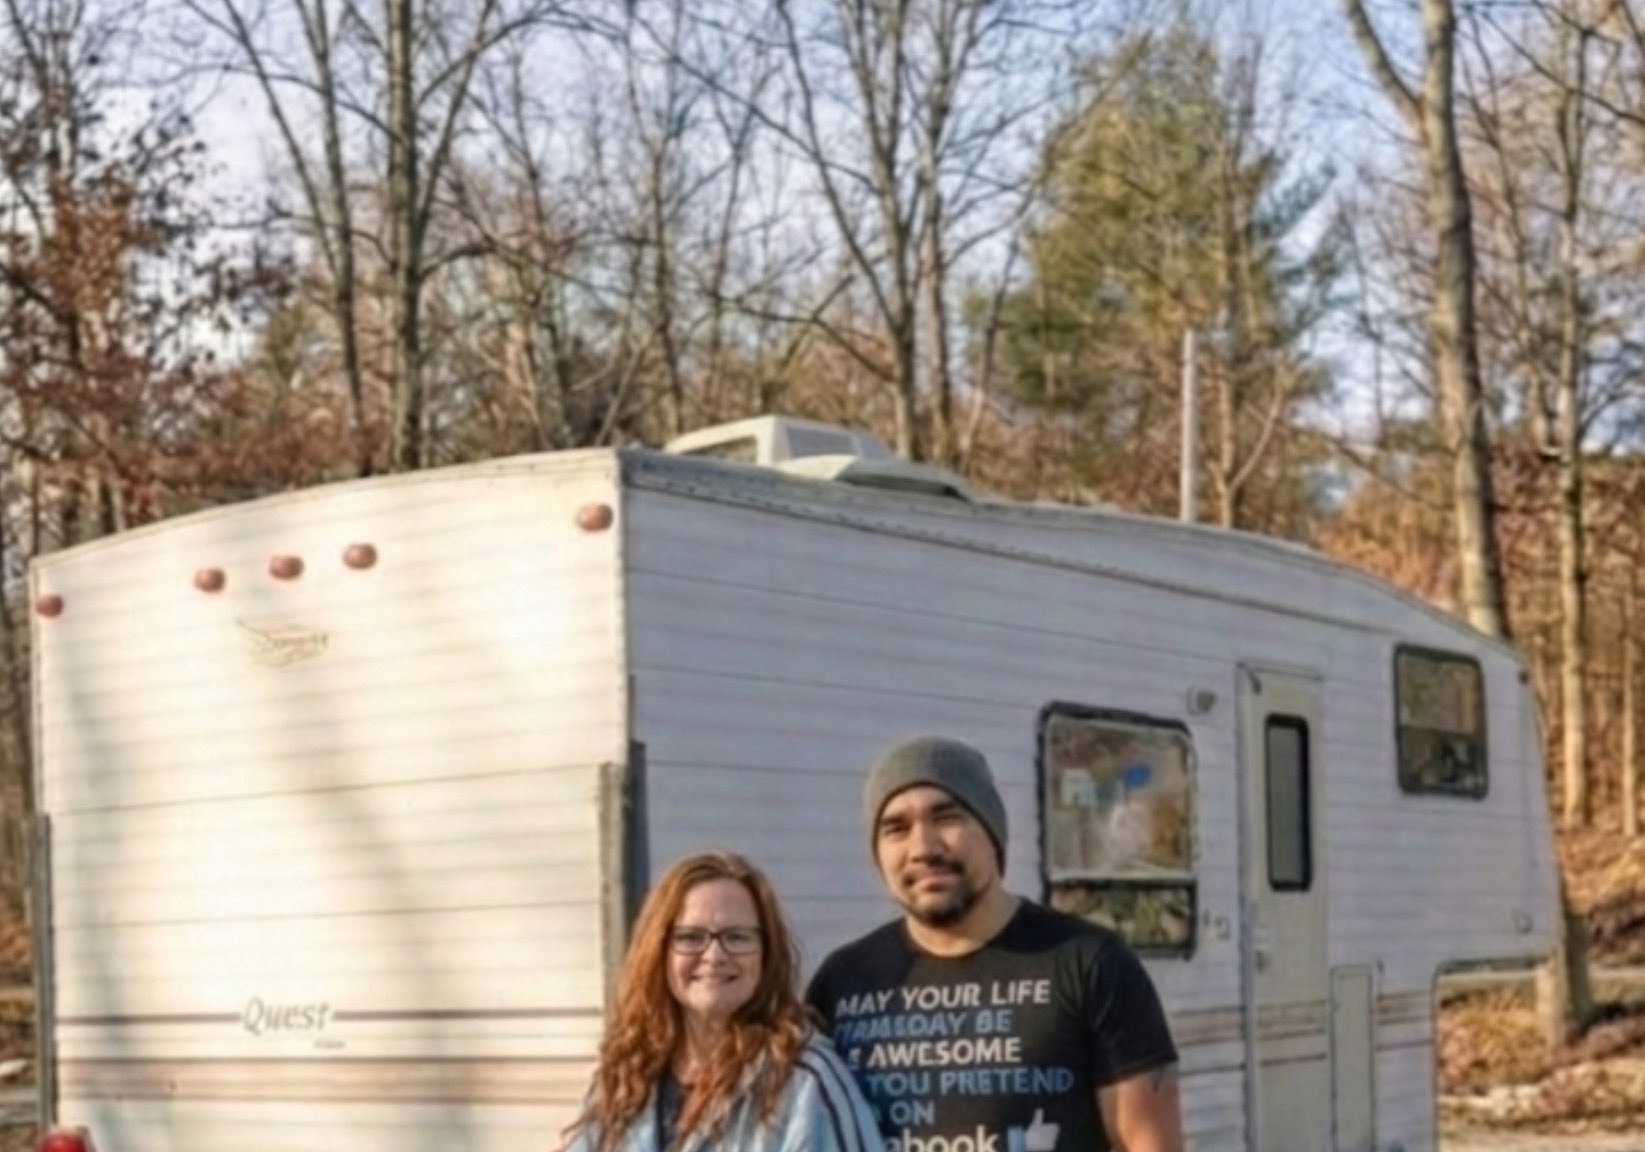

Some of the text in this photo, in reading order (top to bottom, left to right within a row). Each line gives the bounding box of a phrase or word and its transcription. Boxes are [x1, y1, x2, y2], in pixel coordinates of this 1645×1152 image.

[836, 979, 1051, 1017] MAY YOUR LIFE
[243, 996, 330, 1036] Quest
[975, 1009, 1013, 1034] BE
[867, 1037, 1022, 1068] AWESOME
[940, 1067, 1074, 1096] PRETEND
[889, 1100, 935, 1126] ON
